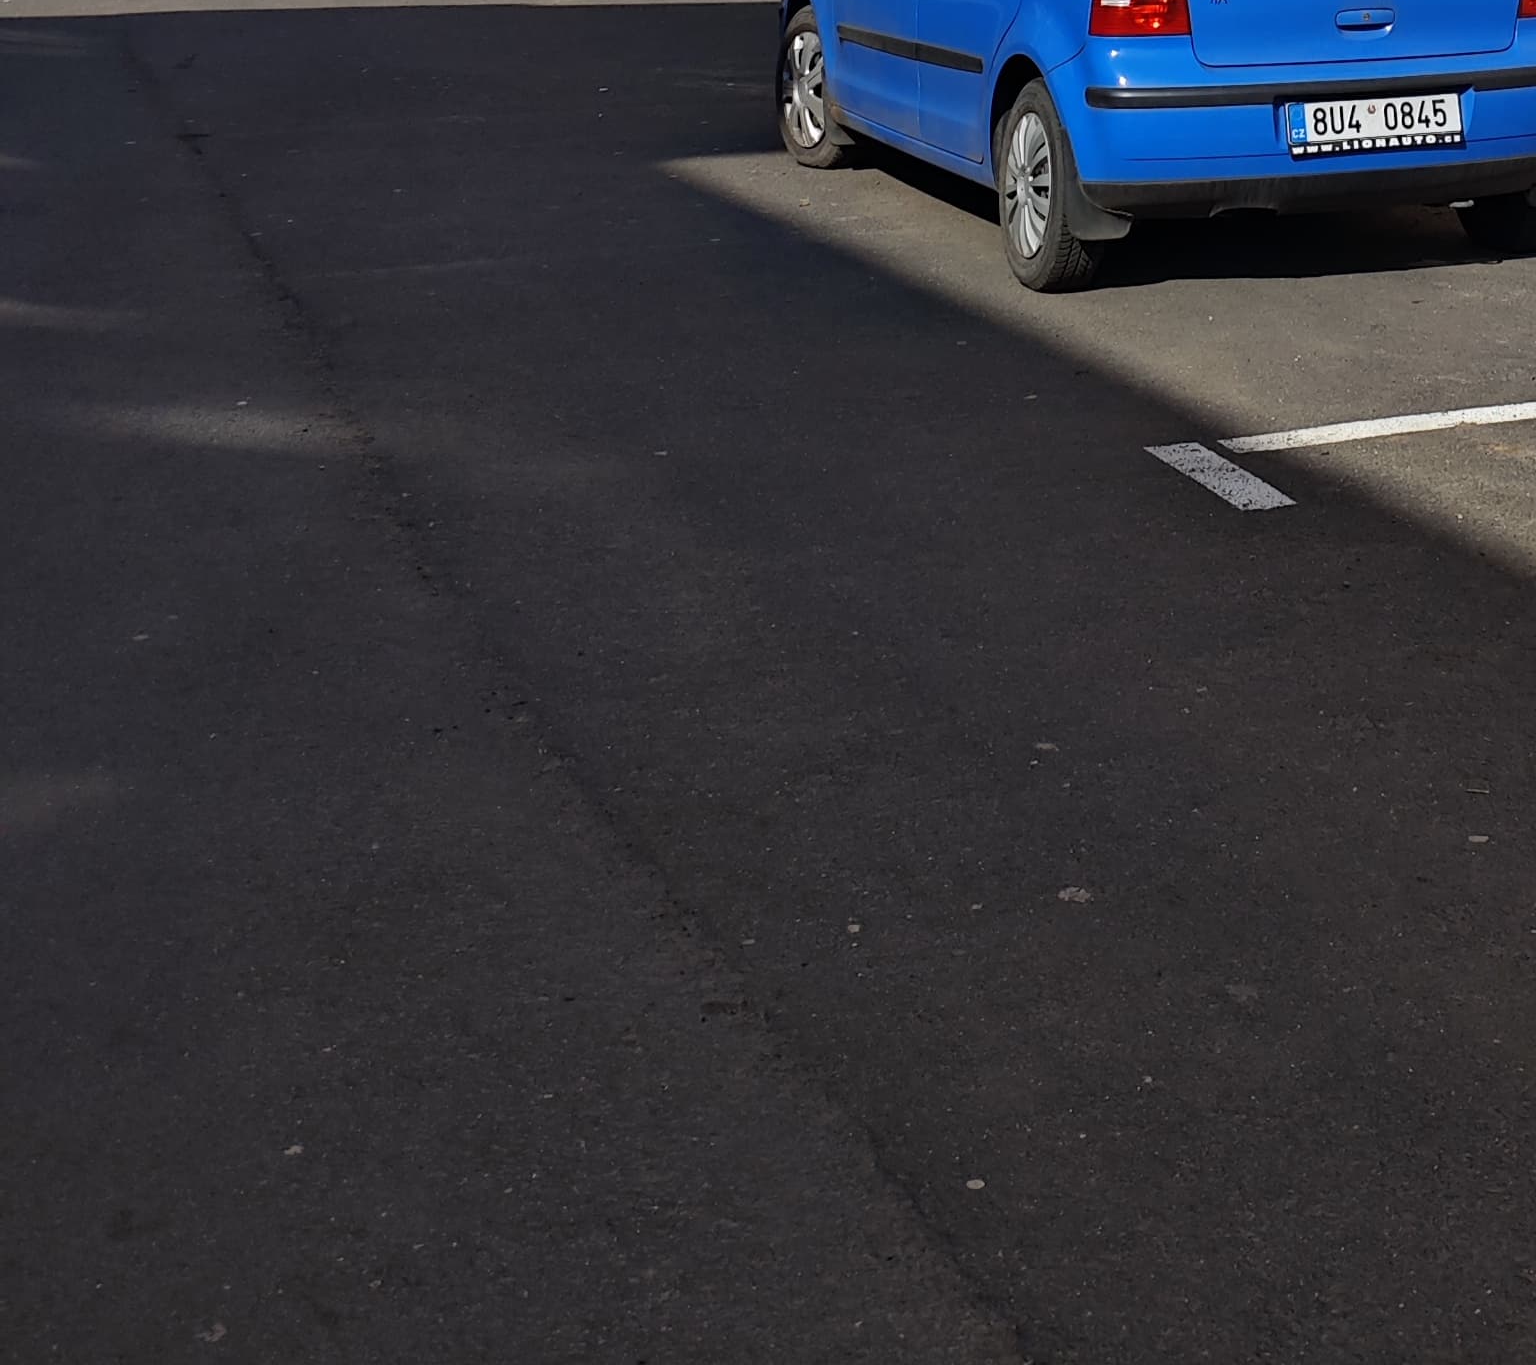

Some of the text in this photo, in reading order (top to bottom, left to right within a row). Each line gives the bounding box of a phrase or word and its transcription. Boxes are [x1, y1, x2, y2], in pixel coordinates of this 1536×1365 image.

[1312, 98, 1448, 136] 8U4 0845
[1291, 127, 1306, 139] CZ
